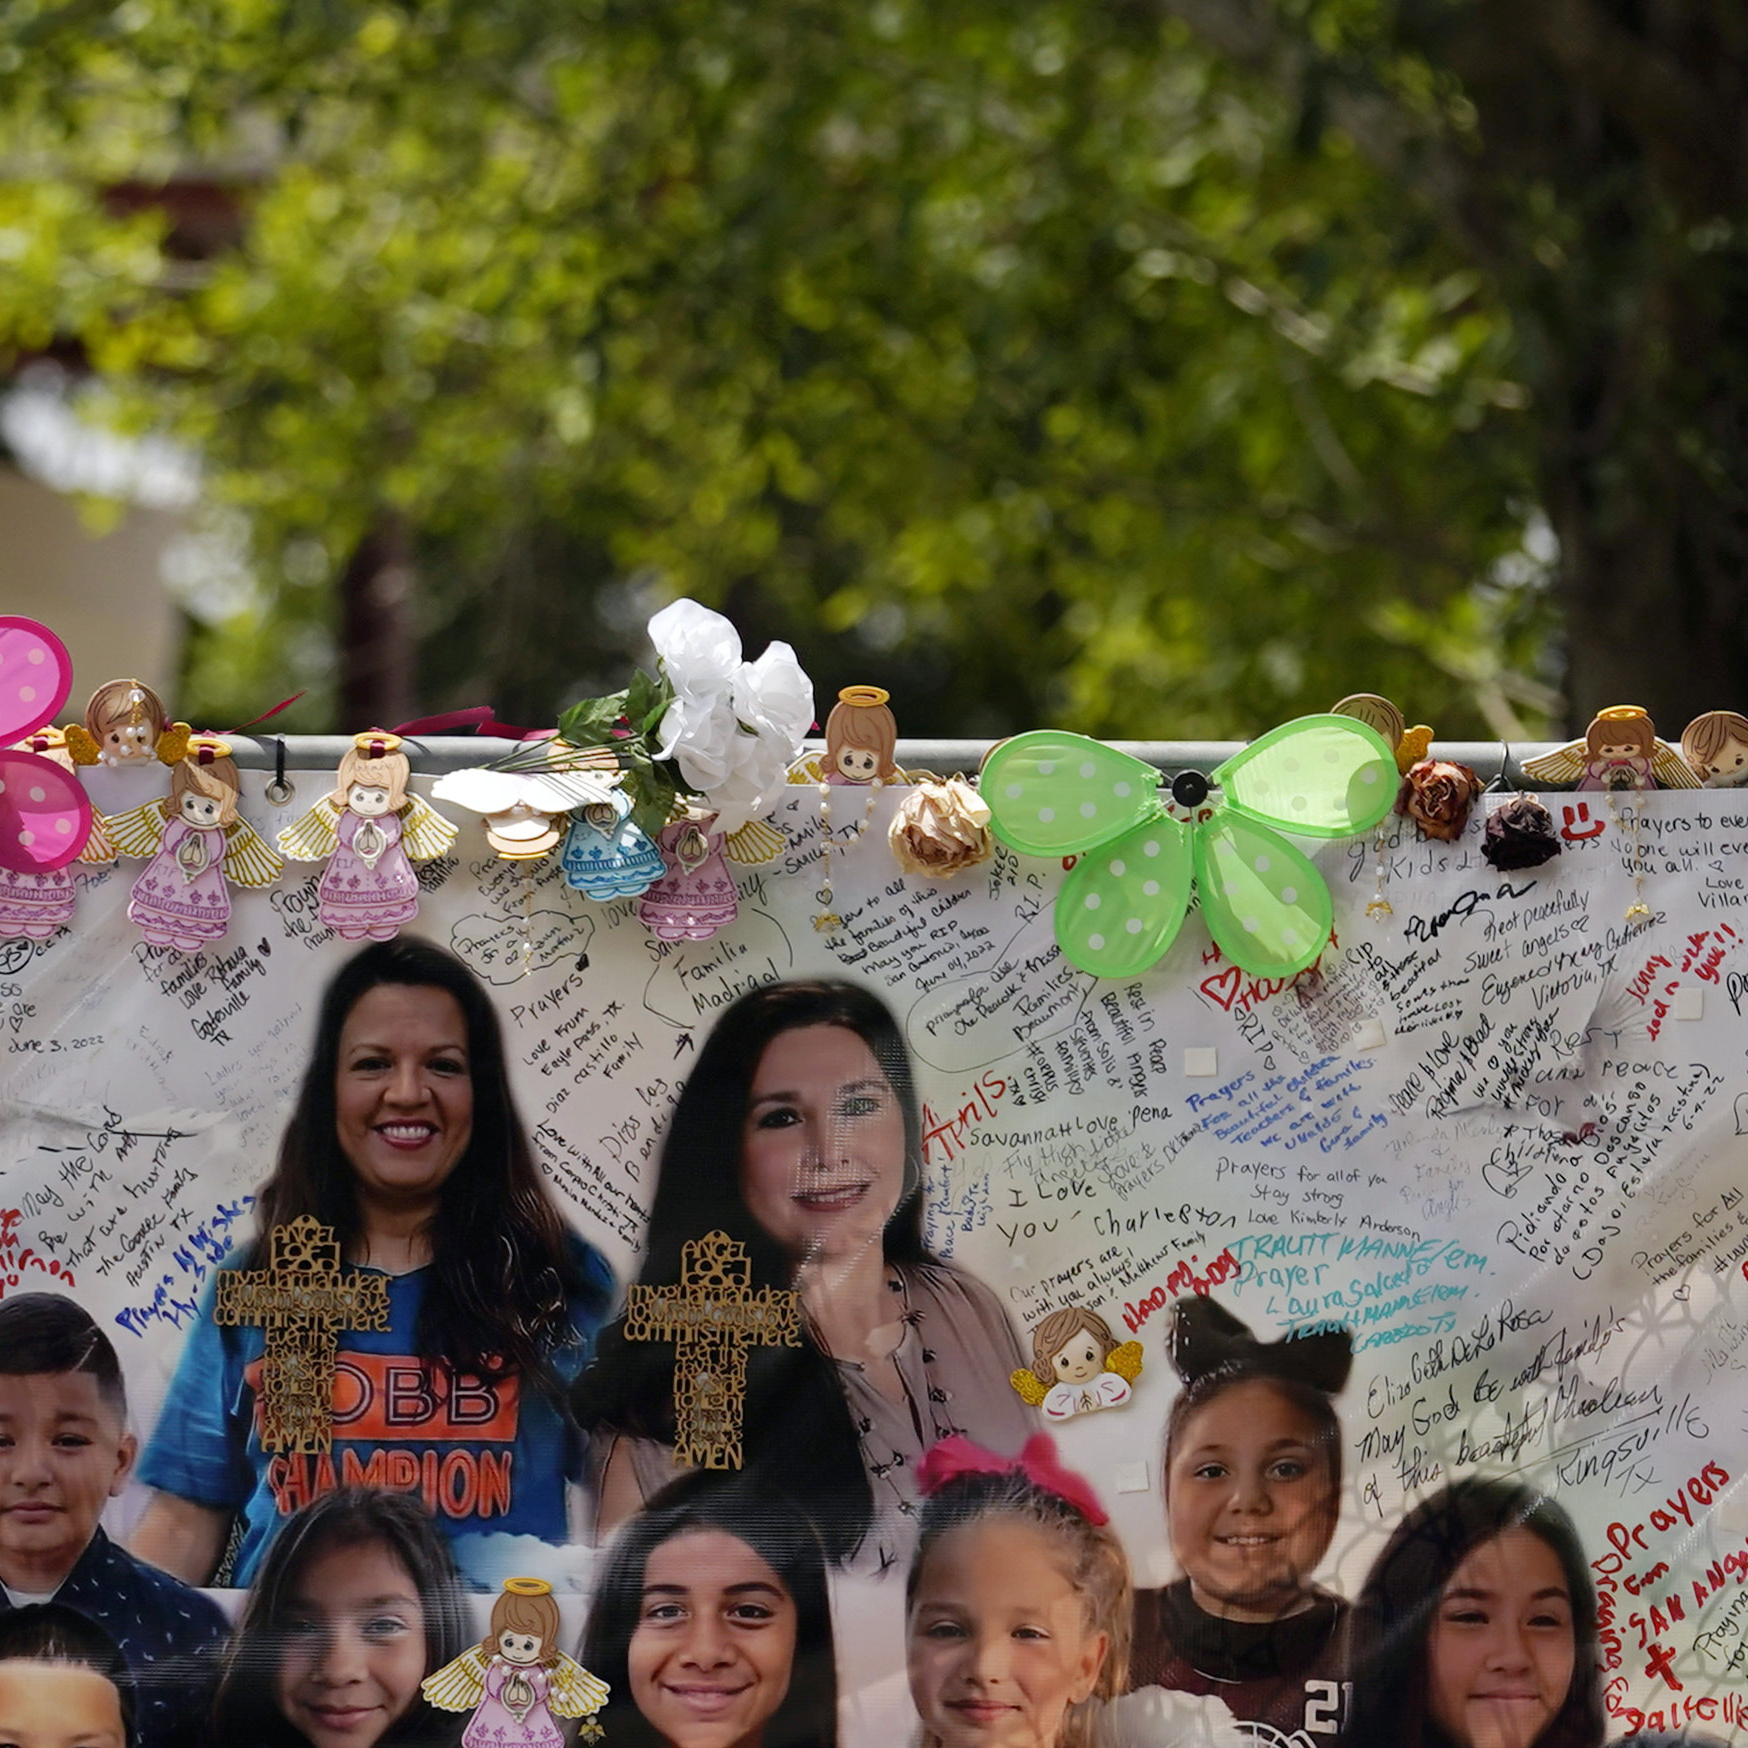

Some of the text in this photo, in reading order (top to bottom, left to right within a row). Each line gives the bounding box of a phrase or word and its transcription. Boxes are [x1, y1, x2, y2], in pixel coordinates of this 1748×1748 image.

[1619, 806, 1691, 836] Prayers
[1696, 815, 1713, 830] to
[1704, 876, 1745, 891] Love
[0, 981, 23, 997] so
[672, 941, 749, 997] Familia
[12, 1000, 37, 1019] are
[510, 970, 586, 1030] Prayers
[72, 1034, 106, 1051] 2022
[602, 1031, 644, 1081] Family
[1631, 1222, 1694, 1273] Prayers
[1605, 1460, 1731, 1563] Prayers
